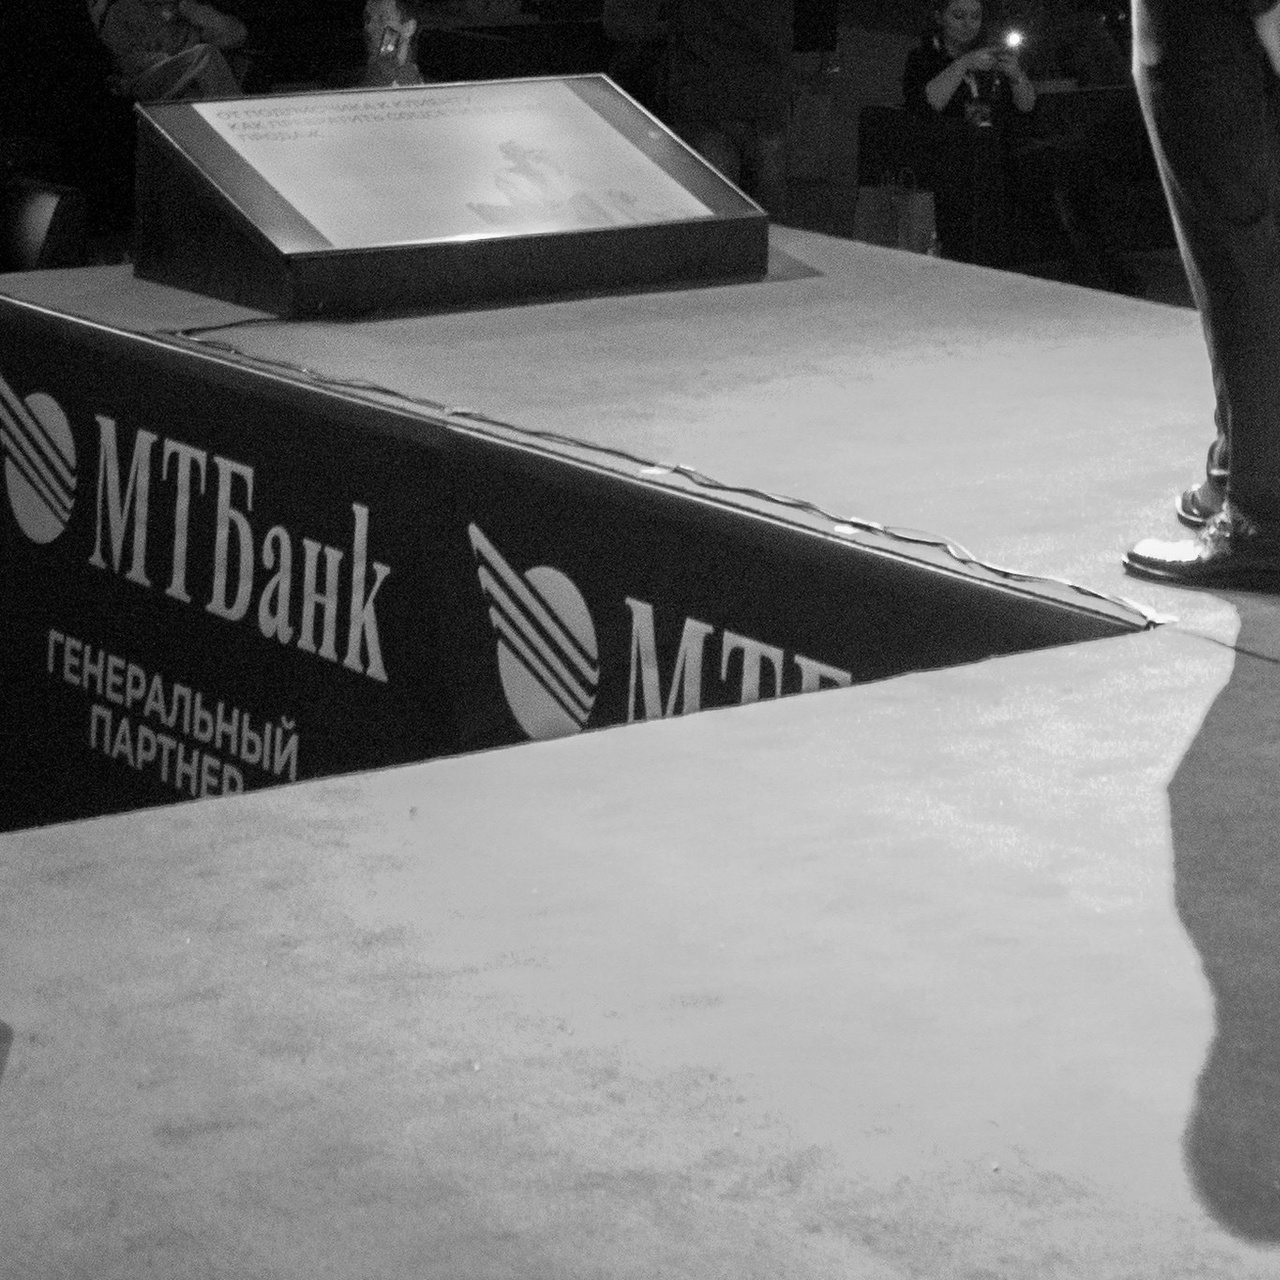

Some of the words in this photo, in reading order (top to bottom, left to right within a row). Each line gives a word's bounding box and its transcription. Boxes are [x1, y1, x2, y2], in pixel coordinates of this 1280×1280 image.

[88, 413, 392, 683] МТБанк
[47, 627, 300, 783] ГЕНЕРАЛЬНЫЙ
[625, 595, 852, 712] МТ
